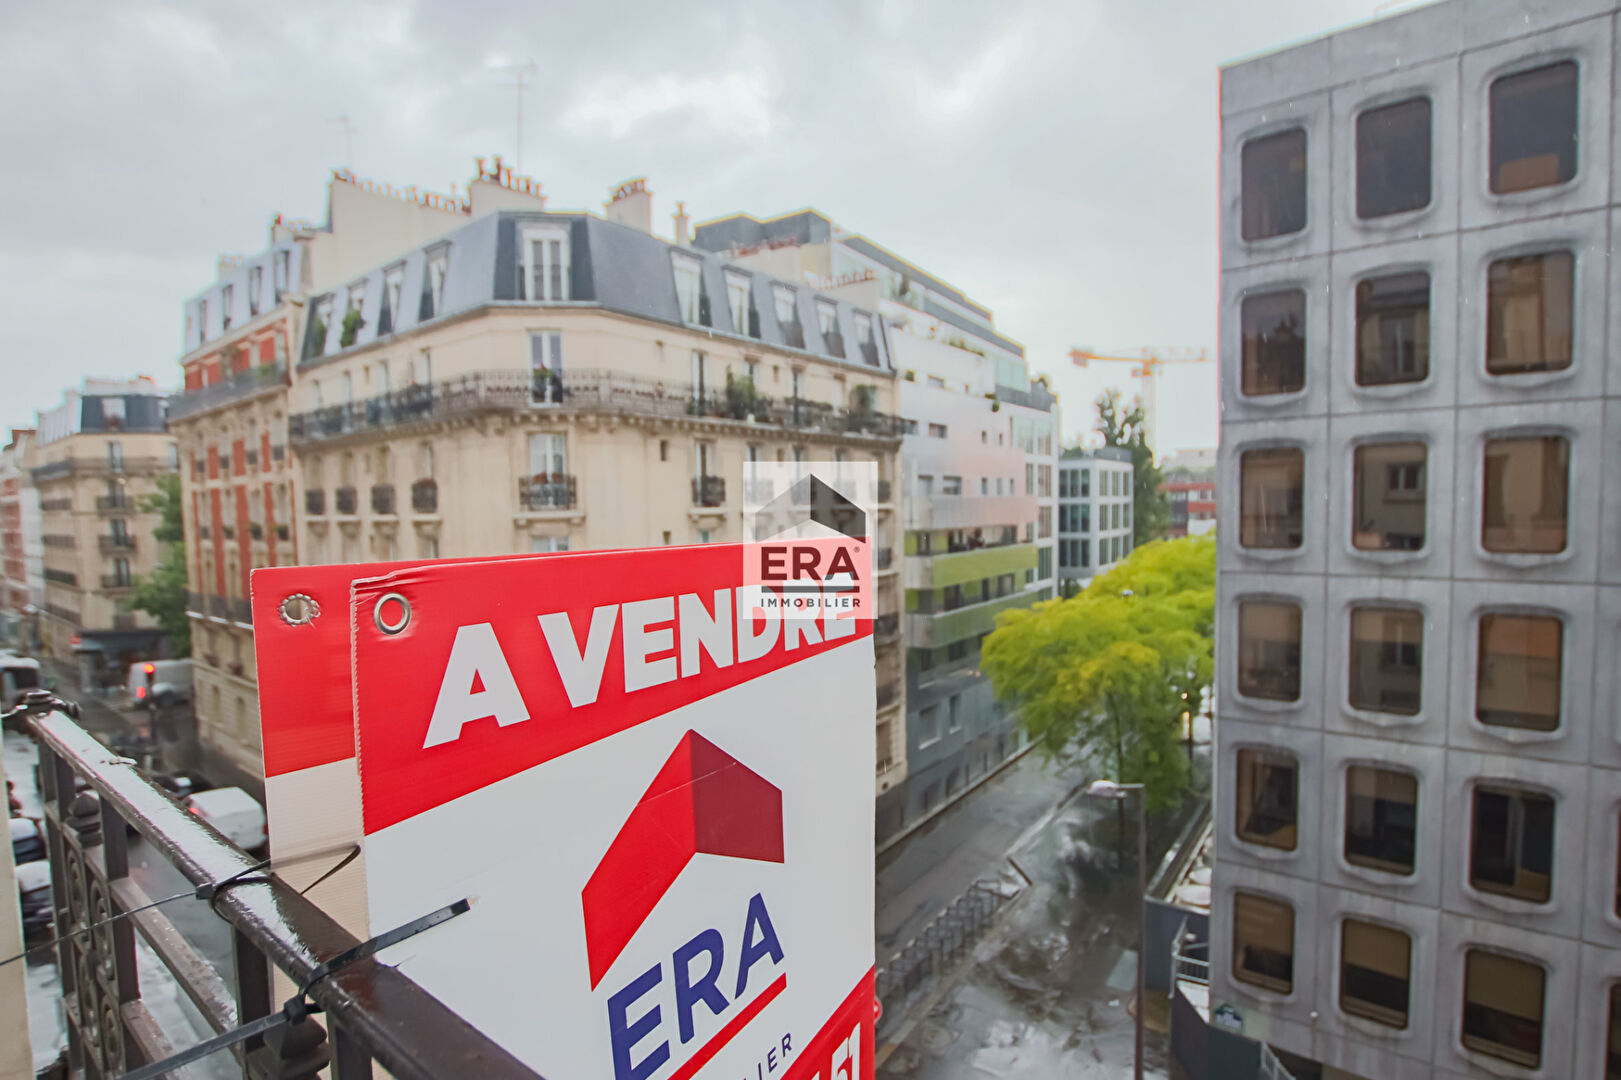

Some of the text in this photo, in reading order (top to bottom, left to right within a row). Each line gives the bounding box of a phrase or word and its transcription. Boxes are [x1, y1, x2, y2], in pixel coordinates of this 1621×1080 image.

[423, 571, 857, 749] A VENDRE
[607, 892, 785, 1080] ERA
